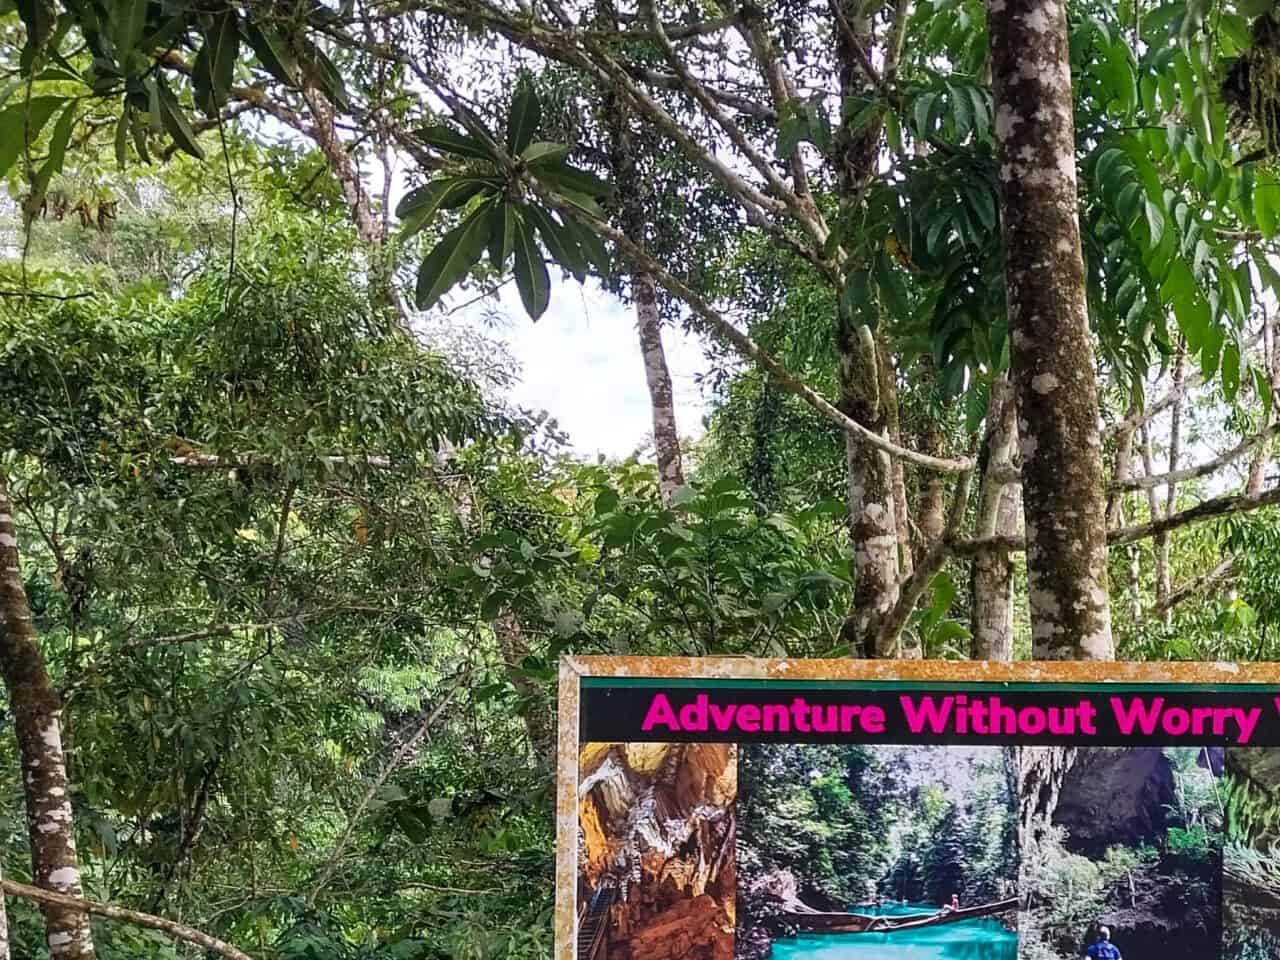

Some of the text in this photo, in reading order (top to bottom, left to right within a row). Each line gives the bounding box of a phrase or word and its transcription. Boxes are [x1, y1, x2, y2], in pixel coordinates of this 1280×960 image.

[641, 693, 886, 733] Adventure
[899, 695, 1097, 735] Without
[1110, 697, 1262, 744] Worry
